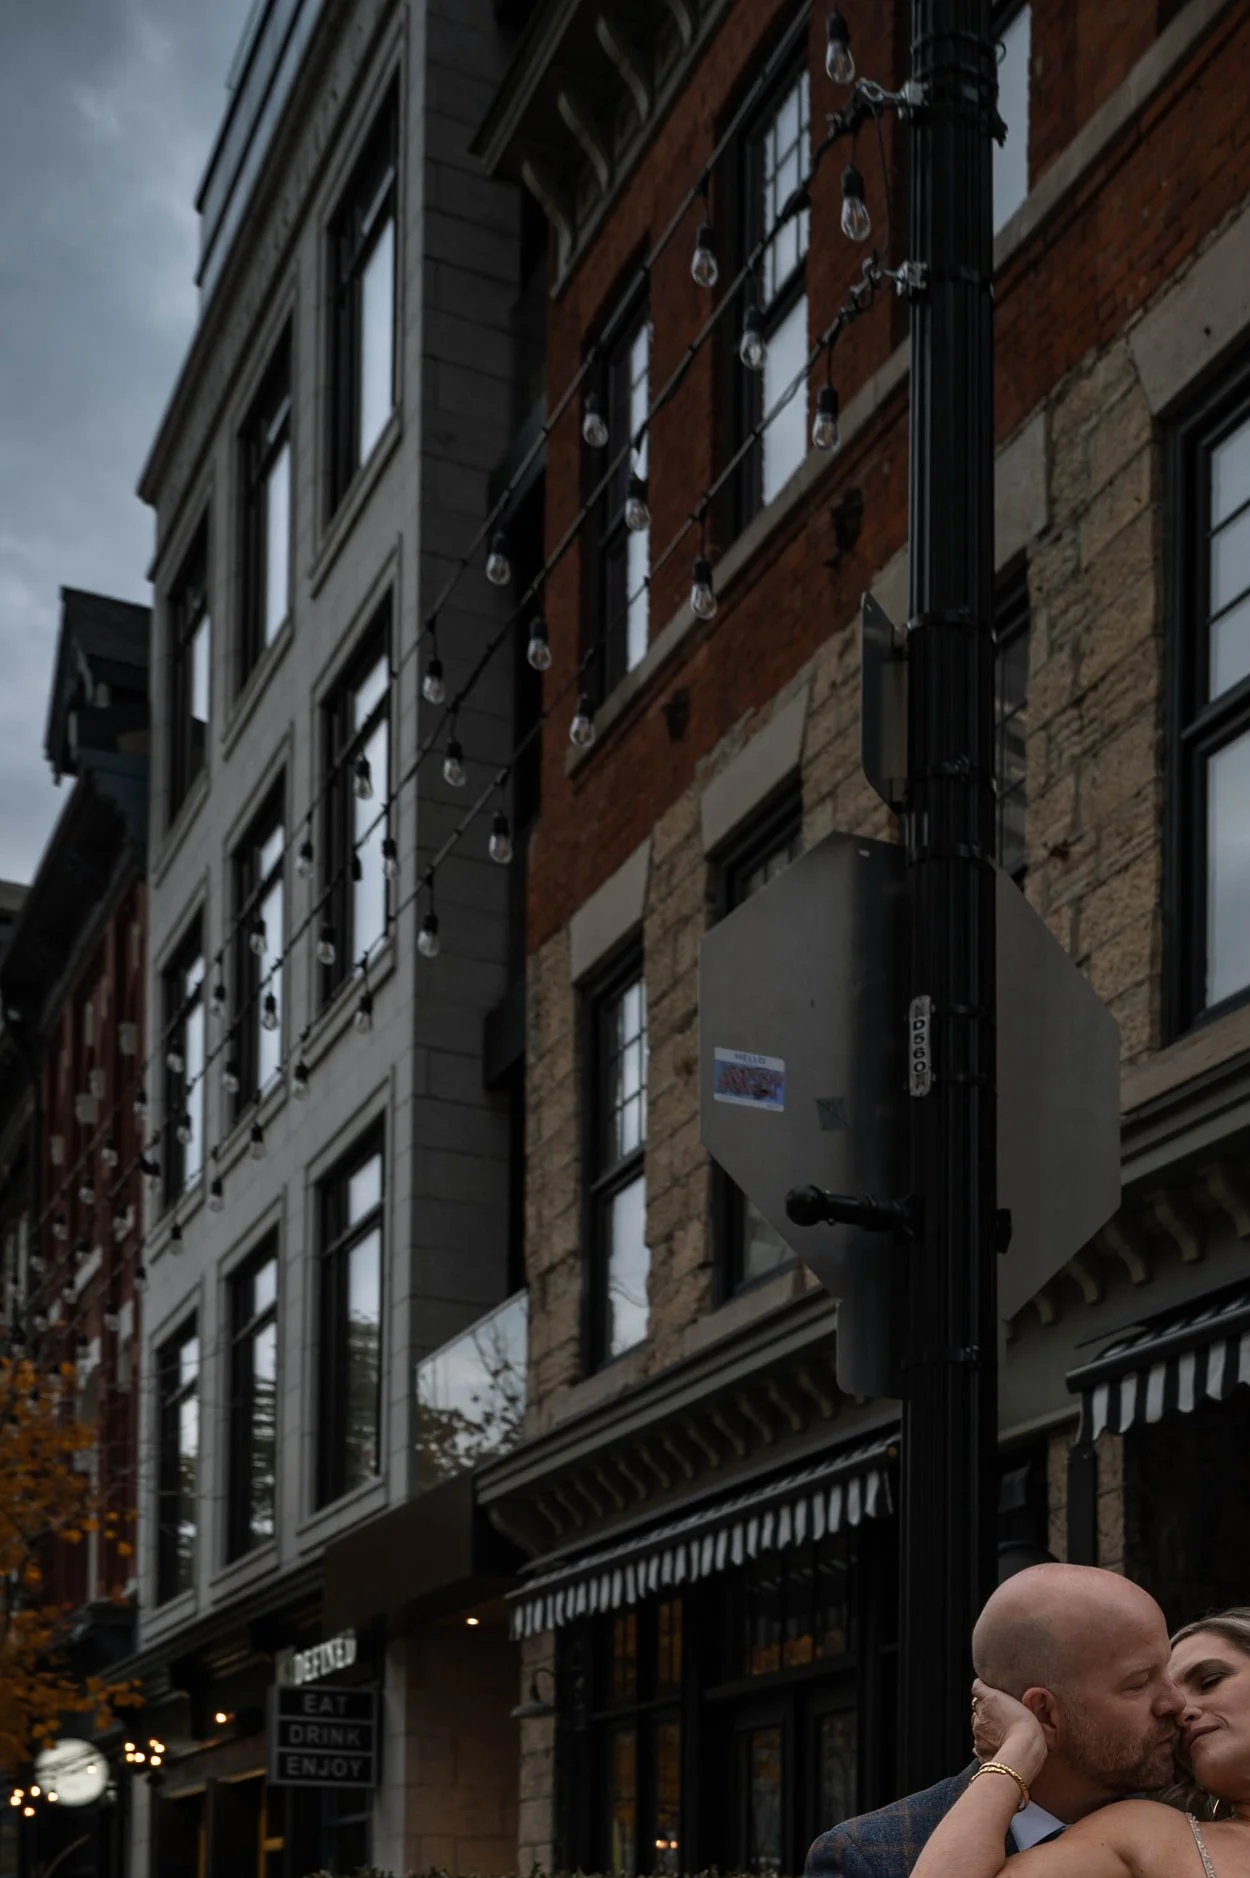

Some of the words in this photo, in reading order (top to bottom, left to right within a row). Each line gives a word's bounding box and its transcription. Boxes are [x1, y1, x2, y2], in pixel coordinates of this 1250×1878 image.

[734, 1052, 766, 1065] HELLO
[302, 1693, 350, 1715] EAT
[288, 1723, 362, 1746] DRINK
[285, 1755, 364, 1778] ENJOY
